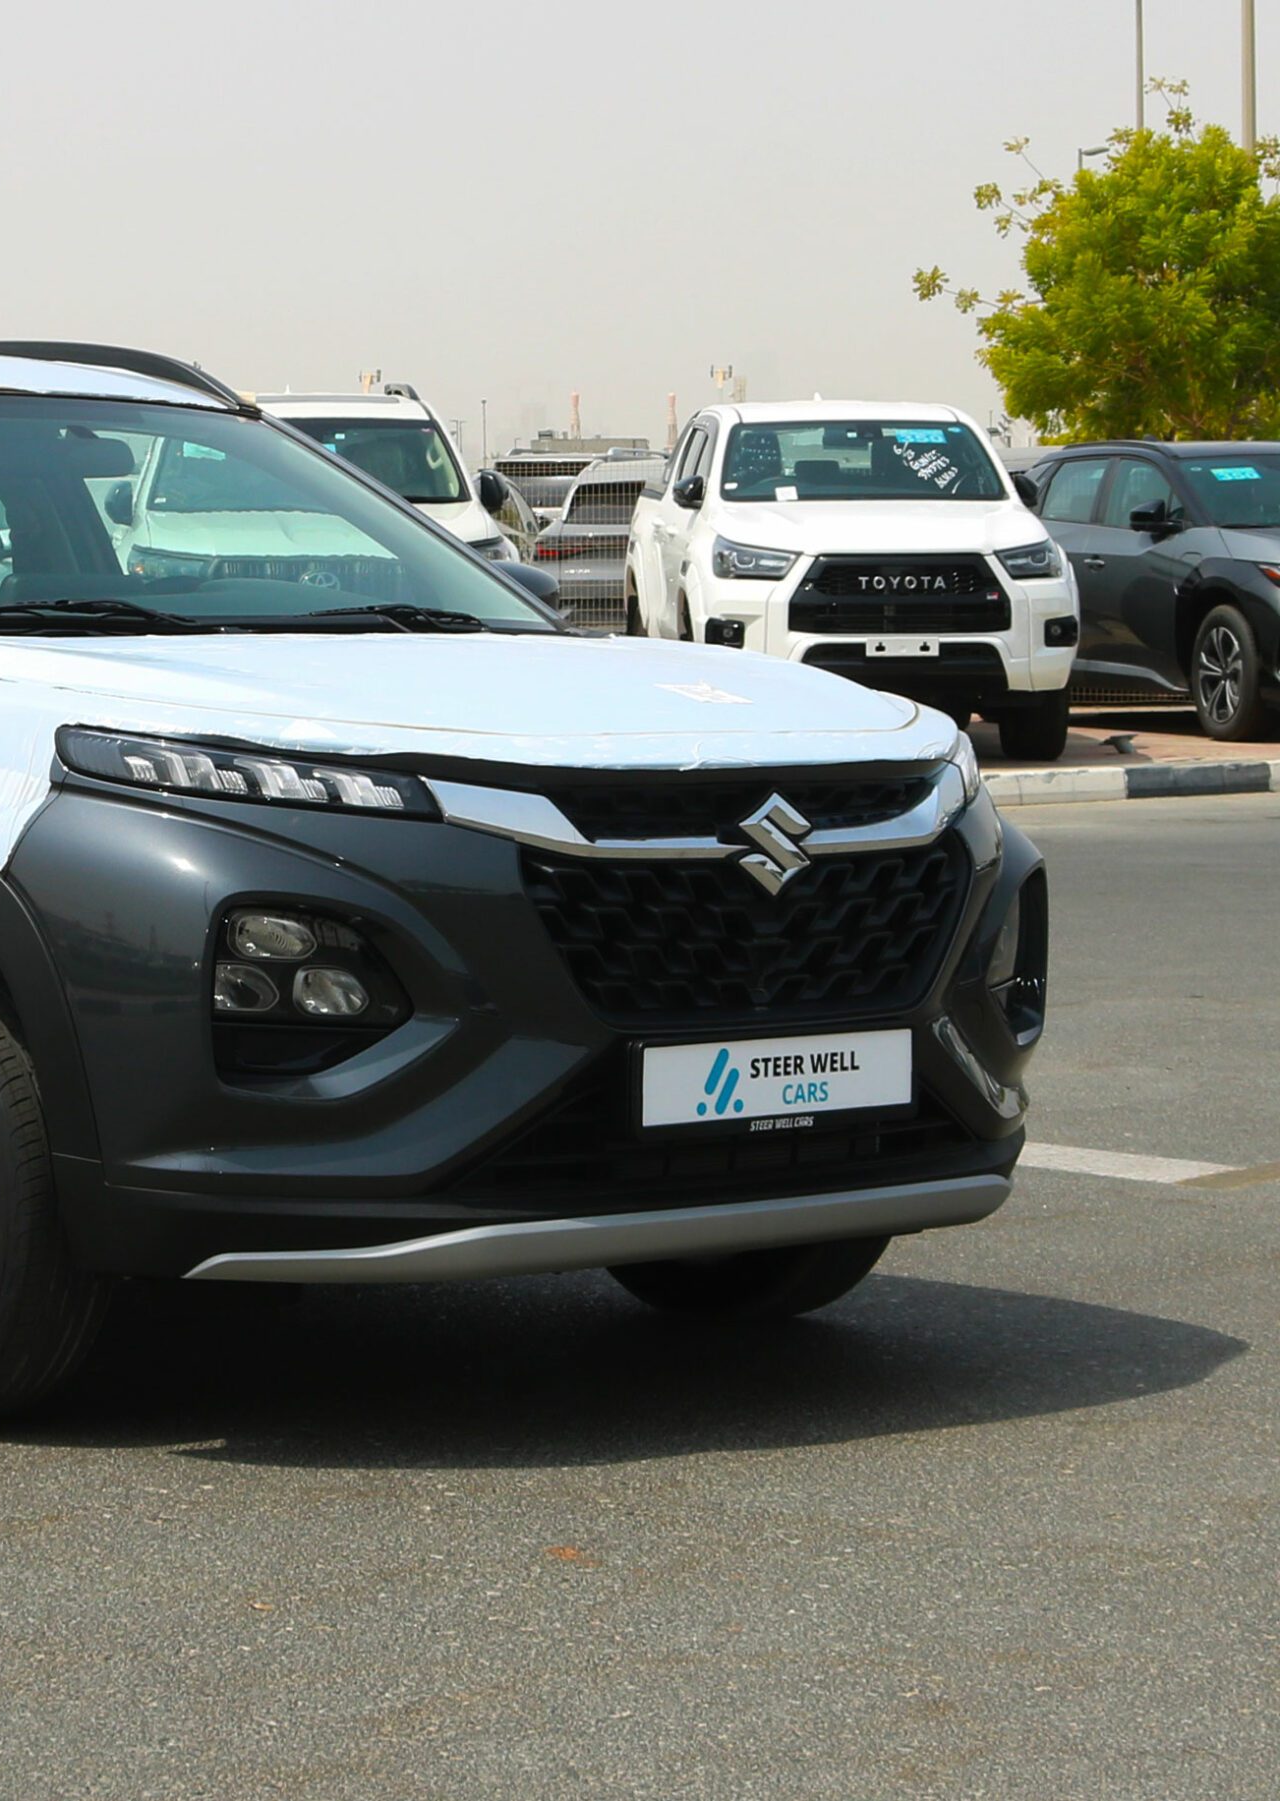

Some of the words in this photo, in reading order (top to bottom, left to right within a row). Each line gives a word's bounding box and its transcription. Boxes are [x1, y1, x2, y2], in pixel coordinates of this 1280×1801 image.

[858, 576, 946, 589] TOYOTA
[750, 1055, 804, 1079] STEER
[810, 1051, 860, 1074] WELL
[782, 1081, 829, 1105] CARS
[749, 1119, 774, 1131] STEER
[775, 1118, 793, 1129] WELL
[793, 1116, 815, 1127] CARS
